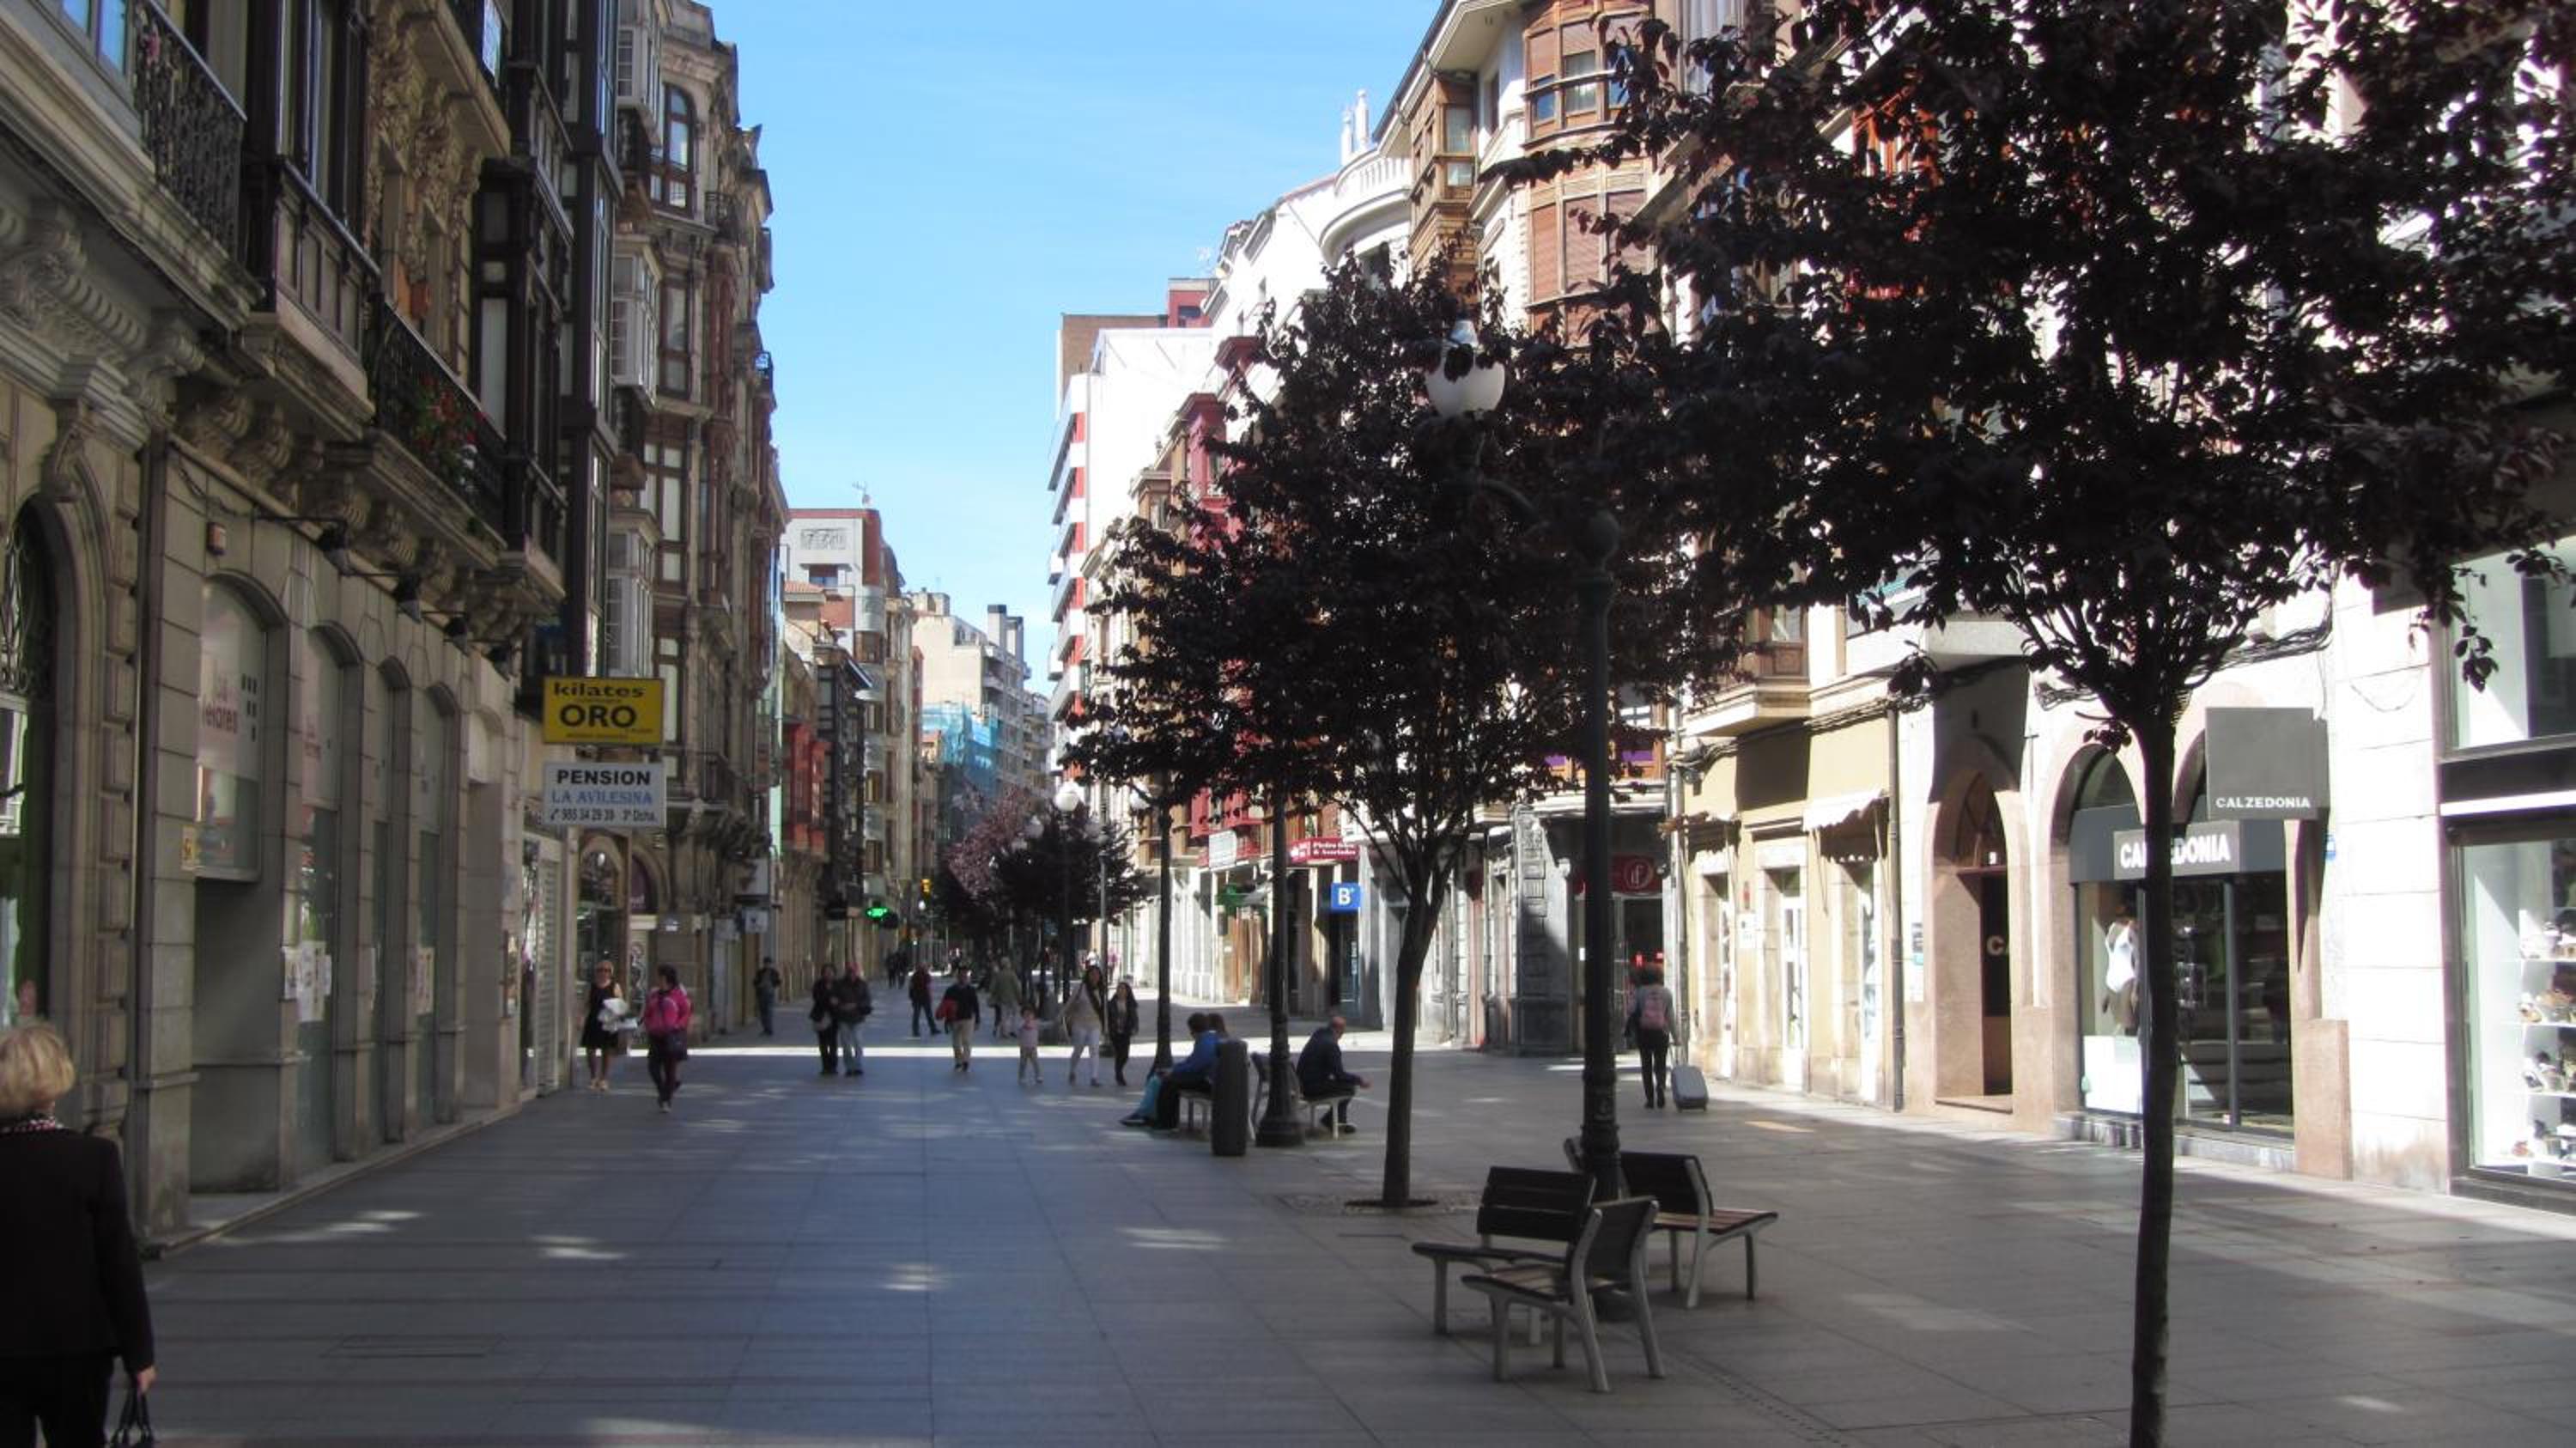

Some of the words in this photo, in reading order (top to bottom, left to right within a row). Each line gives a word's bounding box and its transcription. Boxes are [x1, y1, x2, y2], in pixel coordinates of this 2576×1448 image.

[555, 683, 646, 697] kilates
[560, 704, 636, 727] ORO
[557, 770, 651, 785] PENSION
[551, 790, 571, 804] LA
[2215, 796, 2312, 809] CALZEDONIA
